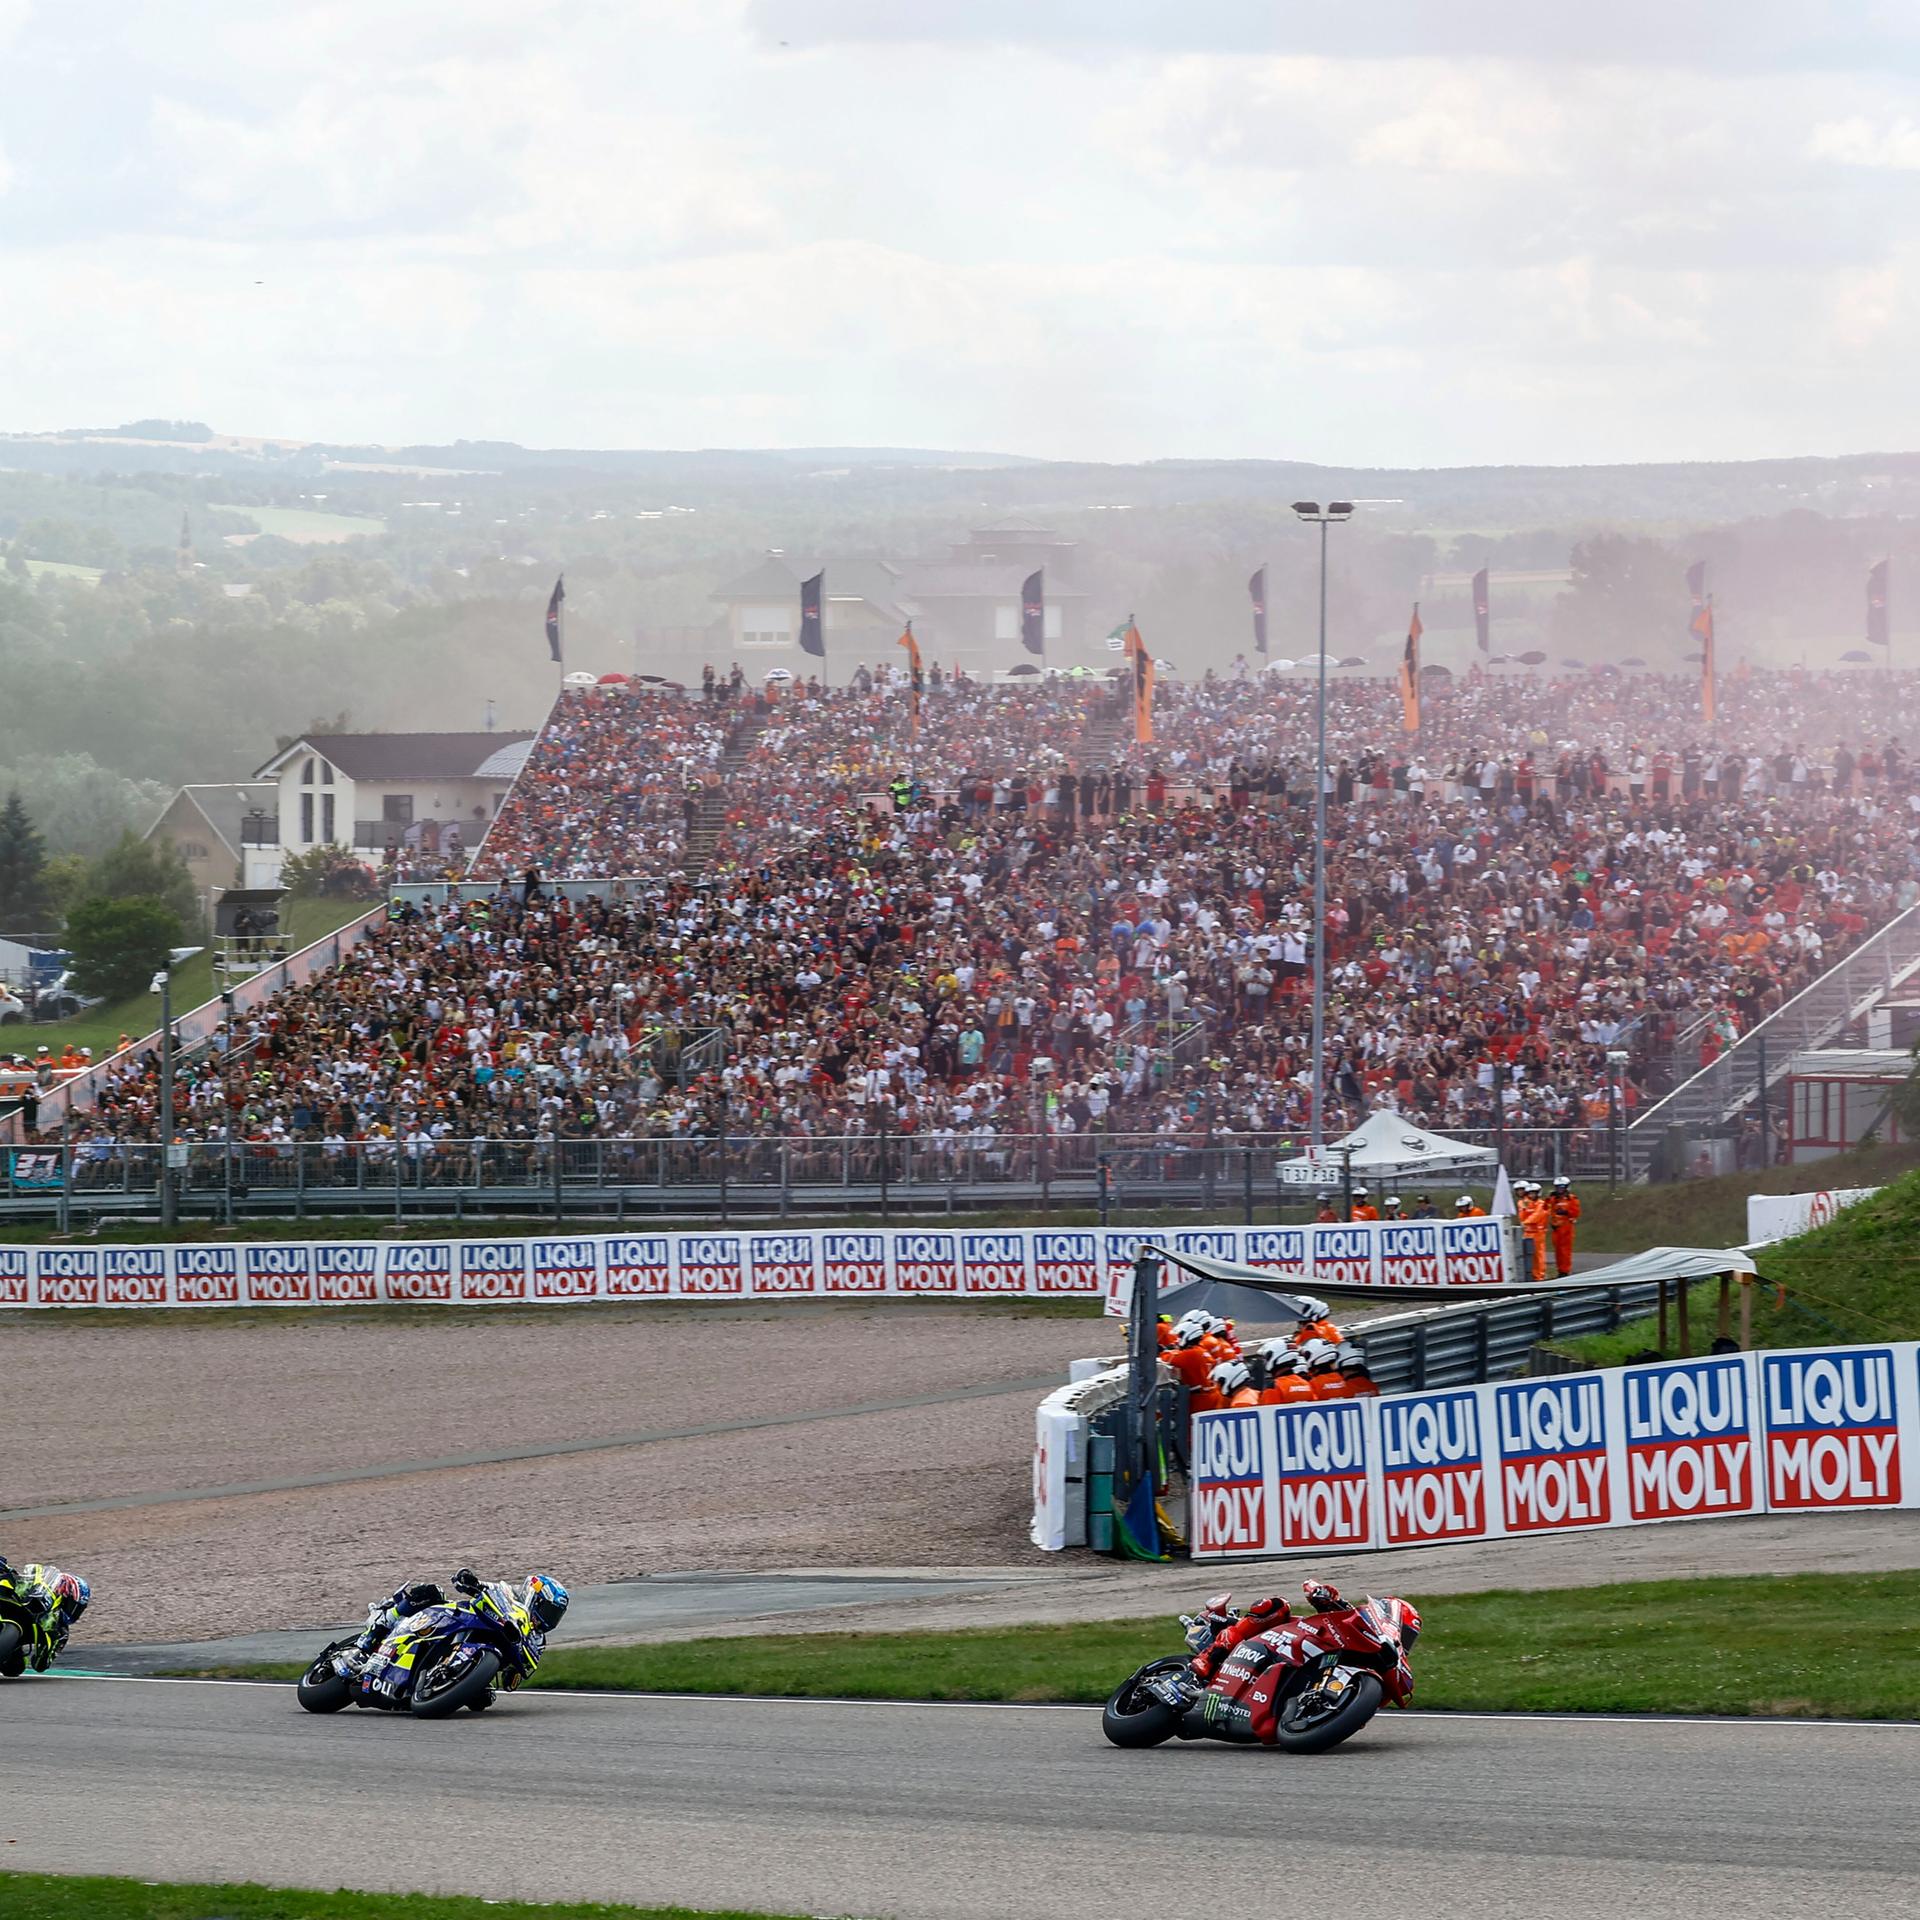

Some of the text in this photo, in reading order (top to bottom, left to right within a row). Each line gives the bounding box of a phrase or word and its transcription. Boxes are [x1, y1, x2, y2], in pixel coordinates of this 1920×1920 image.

[681, 1239, 738, 1264] LIQUI
[752, 1239, 809, 1263] LIQUI
[824, 1237, 882, 1262] LIQUI
[896, 1236, 953, 1261] LIQUI
[963, 1236, 1022, 1261] LIQUI
[1035, 1236, 1094, 1261] LIQUI
[1247, 1234, 1303, 1260] LIQUI
[1315, 1232, 1369, 1257] LIQUI
[1382, 1229, 1435, 1256] LIQUI
[1444, 1226, 1498, 1253] LIQUI
[40, 1253, 95, 1276] LIQUI
[105, 1251, 163, 1275] LIQUI
[177, 1250, 234, 1274] LIQUI
[248, 1249, 307, 1273] LIQUI
[318, 1248, 375, 1273] LIQUI
[388, 1247, 448, 1272] LIQUI
[463, 1246, 522, 1270] LIQUI
[535, 1244, 593, 1268] LIQUI
[608, 1241, 666, 1265] LIQUI
[537, 1270, 596, 1295] MOLY
[608, 1267, 667, 1292] MOLY
[681, 1267, 739, 1291] MOLY
[753, 1266, 813, 1290] MOLY
[825, 1265, 884, 1289] MOLY
[898, 1264, 956, 1289] MOLY
[965, 1264, 1025, 1290] MOLY
[1037, 1264, 1097, 1289] MOLY
[1383, 1259, 1437, 1284] MOLY
[1447, 1256, 1500, 1284] MOLY
[40, 1278, 98, 1301] MOLY
[106, 1277, 164, 1300] MOLY
[179, 1276, 237, 1300] MOLY
[250, 1275, 308, 1299] MOLY
[318, 1275, 375, 1298] MOLY
[387, 1274, 450, 1298] MOLY
[463, 1273, 523, 1297] MOLY
[1628, 1366, 1745, 1438] LIQUI
[1768, 1357, 1892, 1427] LIQUI
[1500, 1382, 1602, 1453] LIQUI
[1278, 1409, 1364, 1473] LIQUI
[1382, 1398, 1478, 1466] LIQUI
[1199, 1417, 1261, 1480] LIQUI
[1631, 1441, 1751, 1513] MOLY
[1772, 1433, 1898, 1501] MOLY
[1387, 1468, 1483, 1537] MOLY
[1505, 1456, 1607, 1525] MOLY
[1199, 1486, 1263, 1546] MOLY
[1282, 1478, 1368, 1541] MOLY
[1232, 1644, 1266, 1663] Lenov
